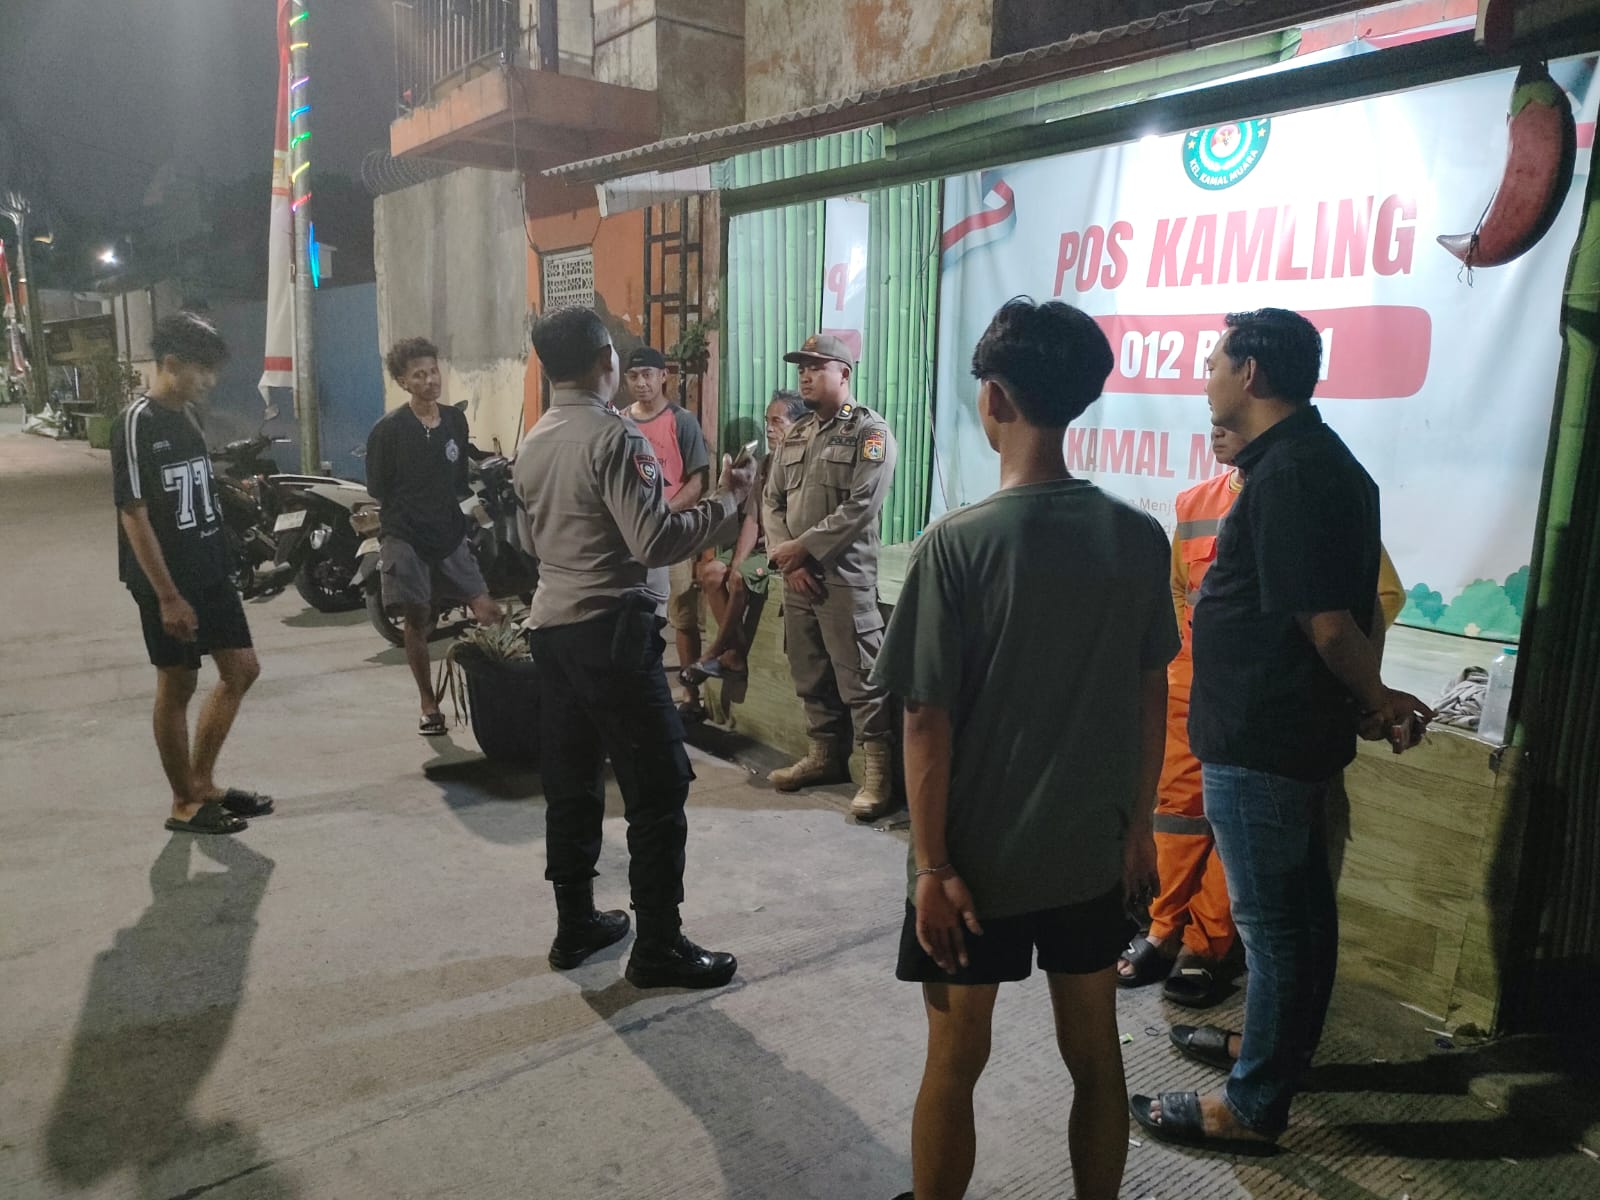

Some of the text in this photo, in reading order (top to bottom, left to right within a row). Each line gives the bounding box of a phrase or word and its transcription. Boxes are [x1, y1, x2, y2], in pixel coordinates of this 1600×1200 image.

[1199, 172, 1229, 186] KAMAL
[1229, 150, 1259, 182] MUARA
[1053, 193, 1418, 297] POS KAMLING
[1119, 330, 1228, 380] 012 R
[1066, 427, 1175, 478] KAMAL
